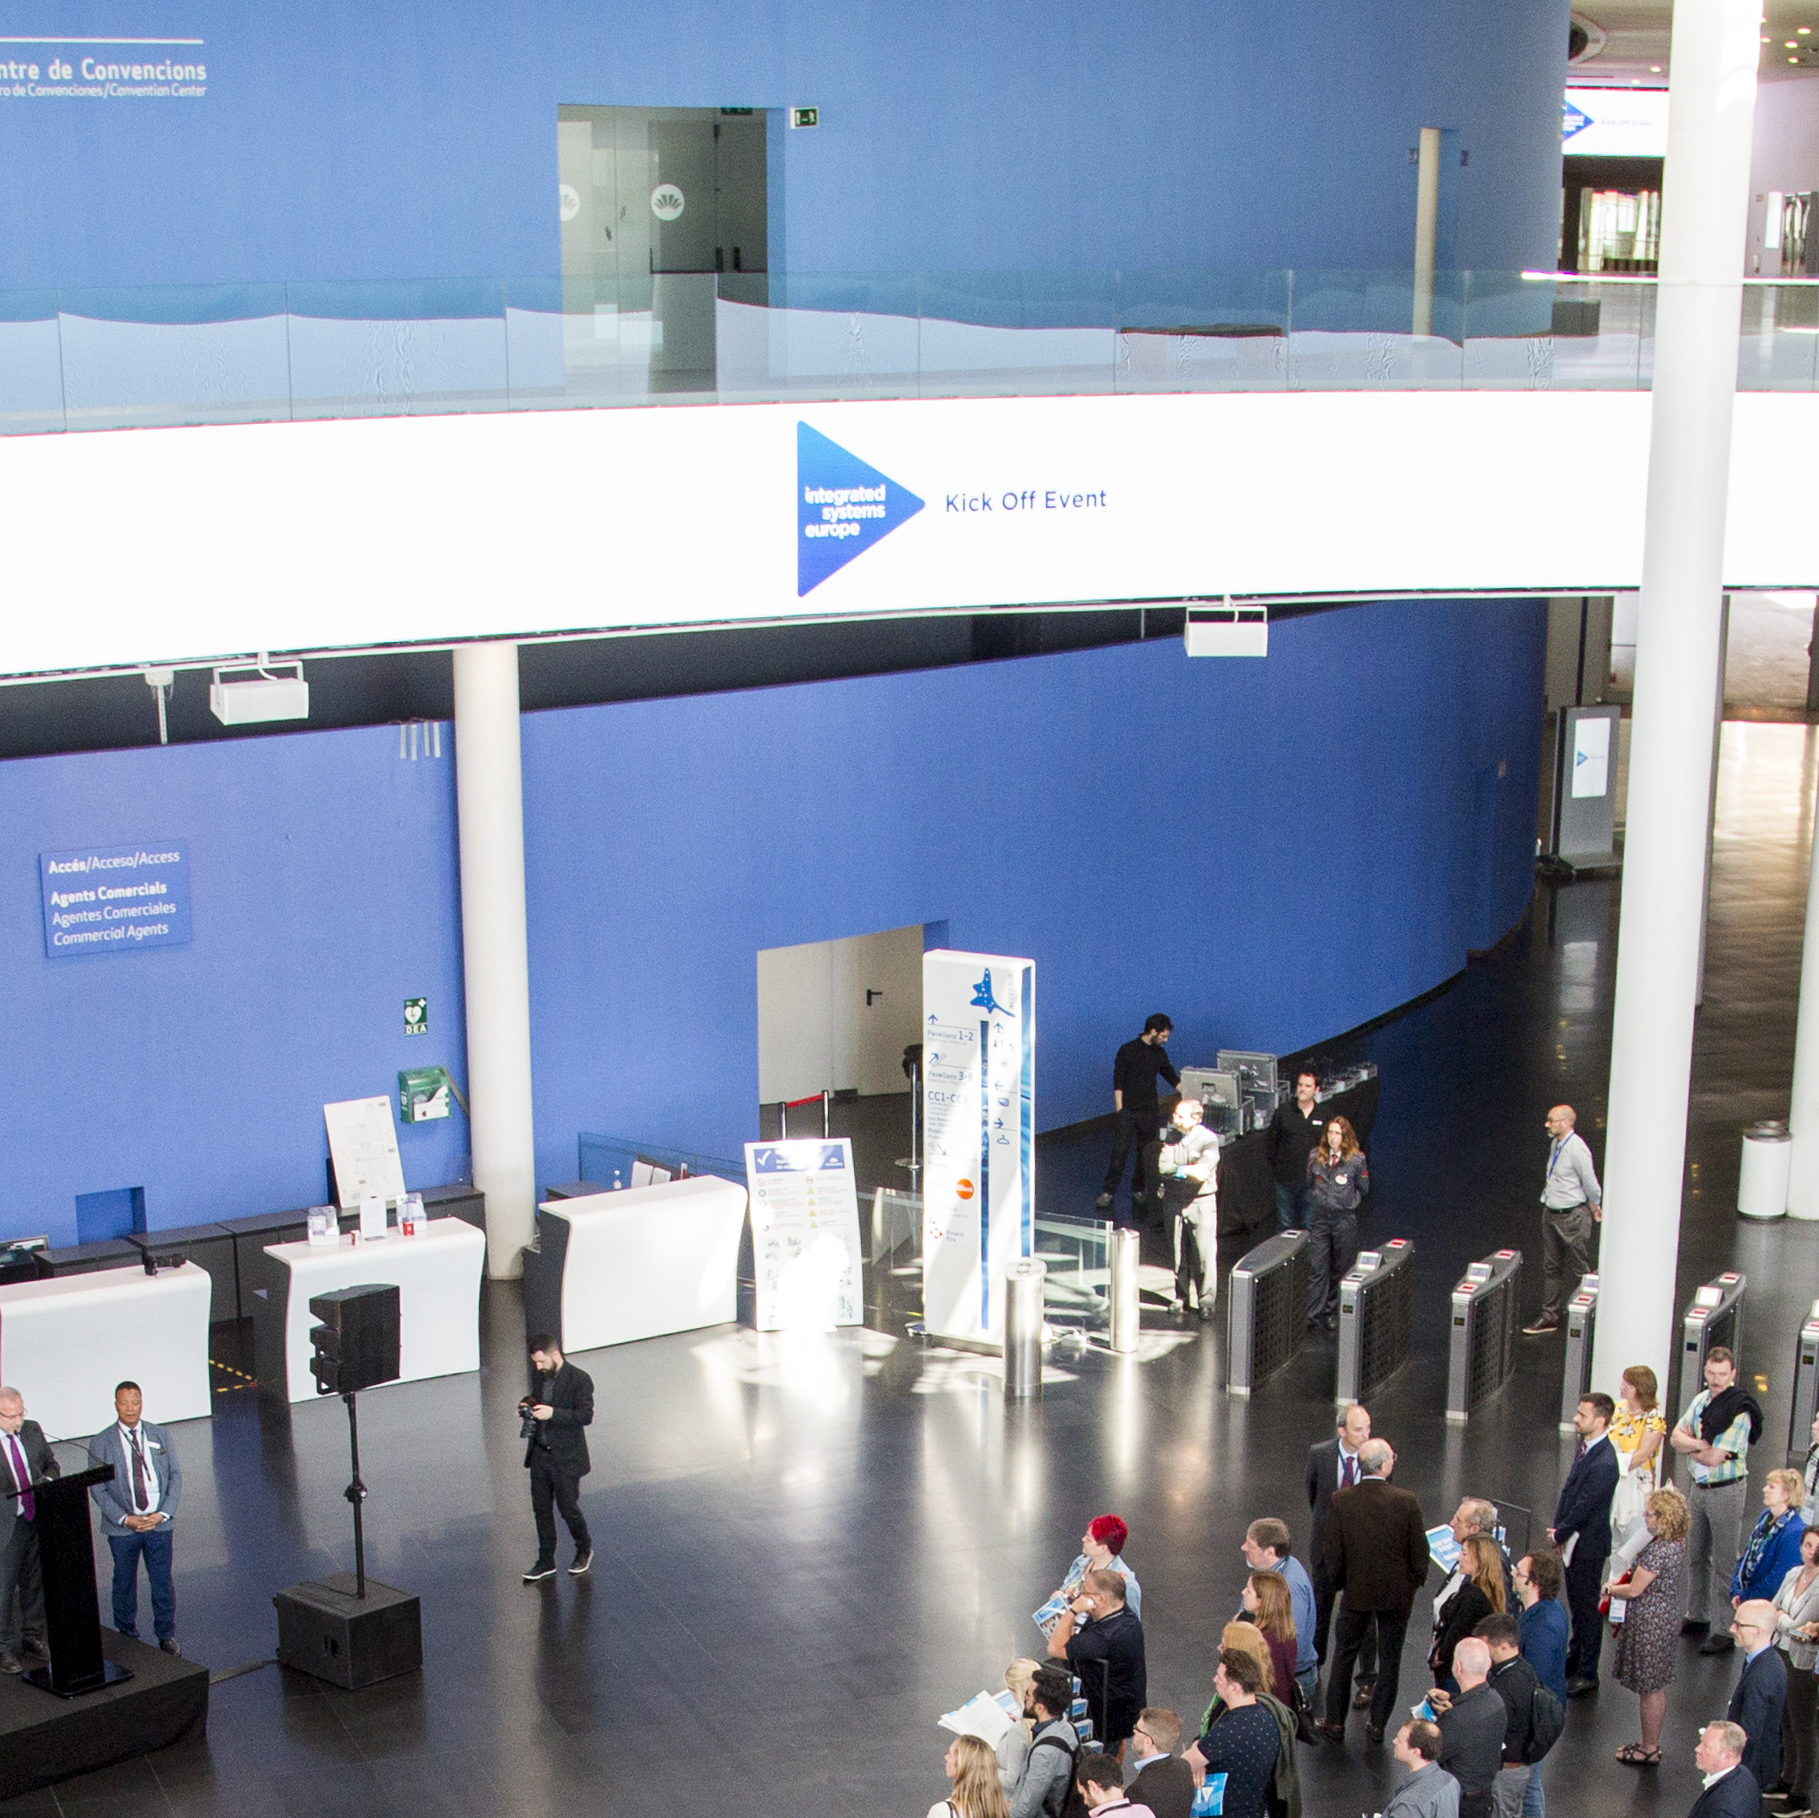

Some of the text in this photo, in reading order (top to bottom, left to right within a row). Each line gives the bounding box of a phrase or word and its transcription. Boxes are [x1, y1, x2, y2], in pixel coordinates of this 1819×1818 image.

[48, 58, 72, 79] de
[82, 58, 207, 80] Convencions
[12, 83, 26, 97] de
[171, 83, 207, 97] Center
[804, 485, 886, 505] integrated
[945, 489, 1107, 513] Kick Off Event
[822, 503, 886, 522] systems
[805, 523, 860, 539] europe
[51, 882, 167, 908] Agents Comercials
[52, 902, 177, 928] Agentes Comerciales
[54, 923, 169, 946] Commercial Agents
[405, 1024, 427, 1035] DEA
[959, 1031, 974, 1042] 1-2
